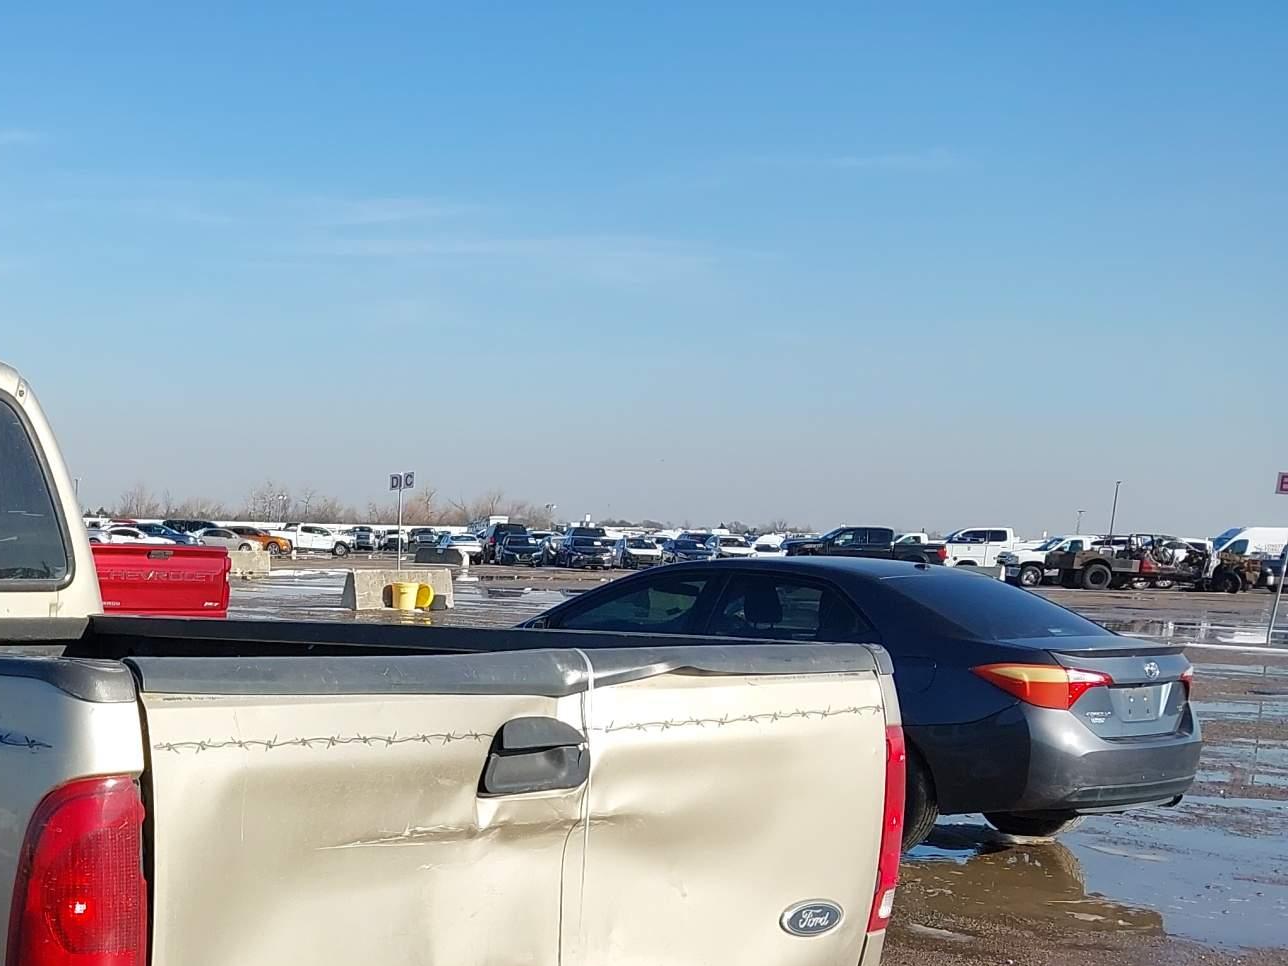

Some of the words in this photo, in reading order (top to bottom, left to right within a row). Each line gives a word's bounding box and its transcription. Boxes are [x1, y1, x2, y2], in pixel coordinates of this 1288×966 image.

[391, 476, 398, 488] D
[405, 474, 413, 486] C
[798, 908, 830, 929] Ford
